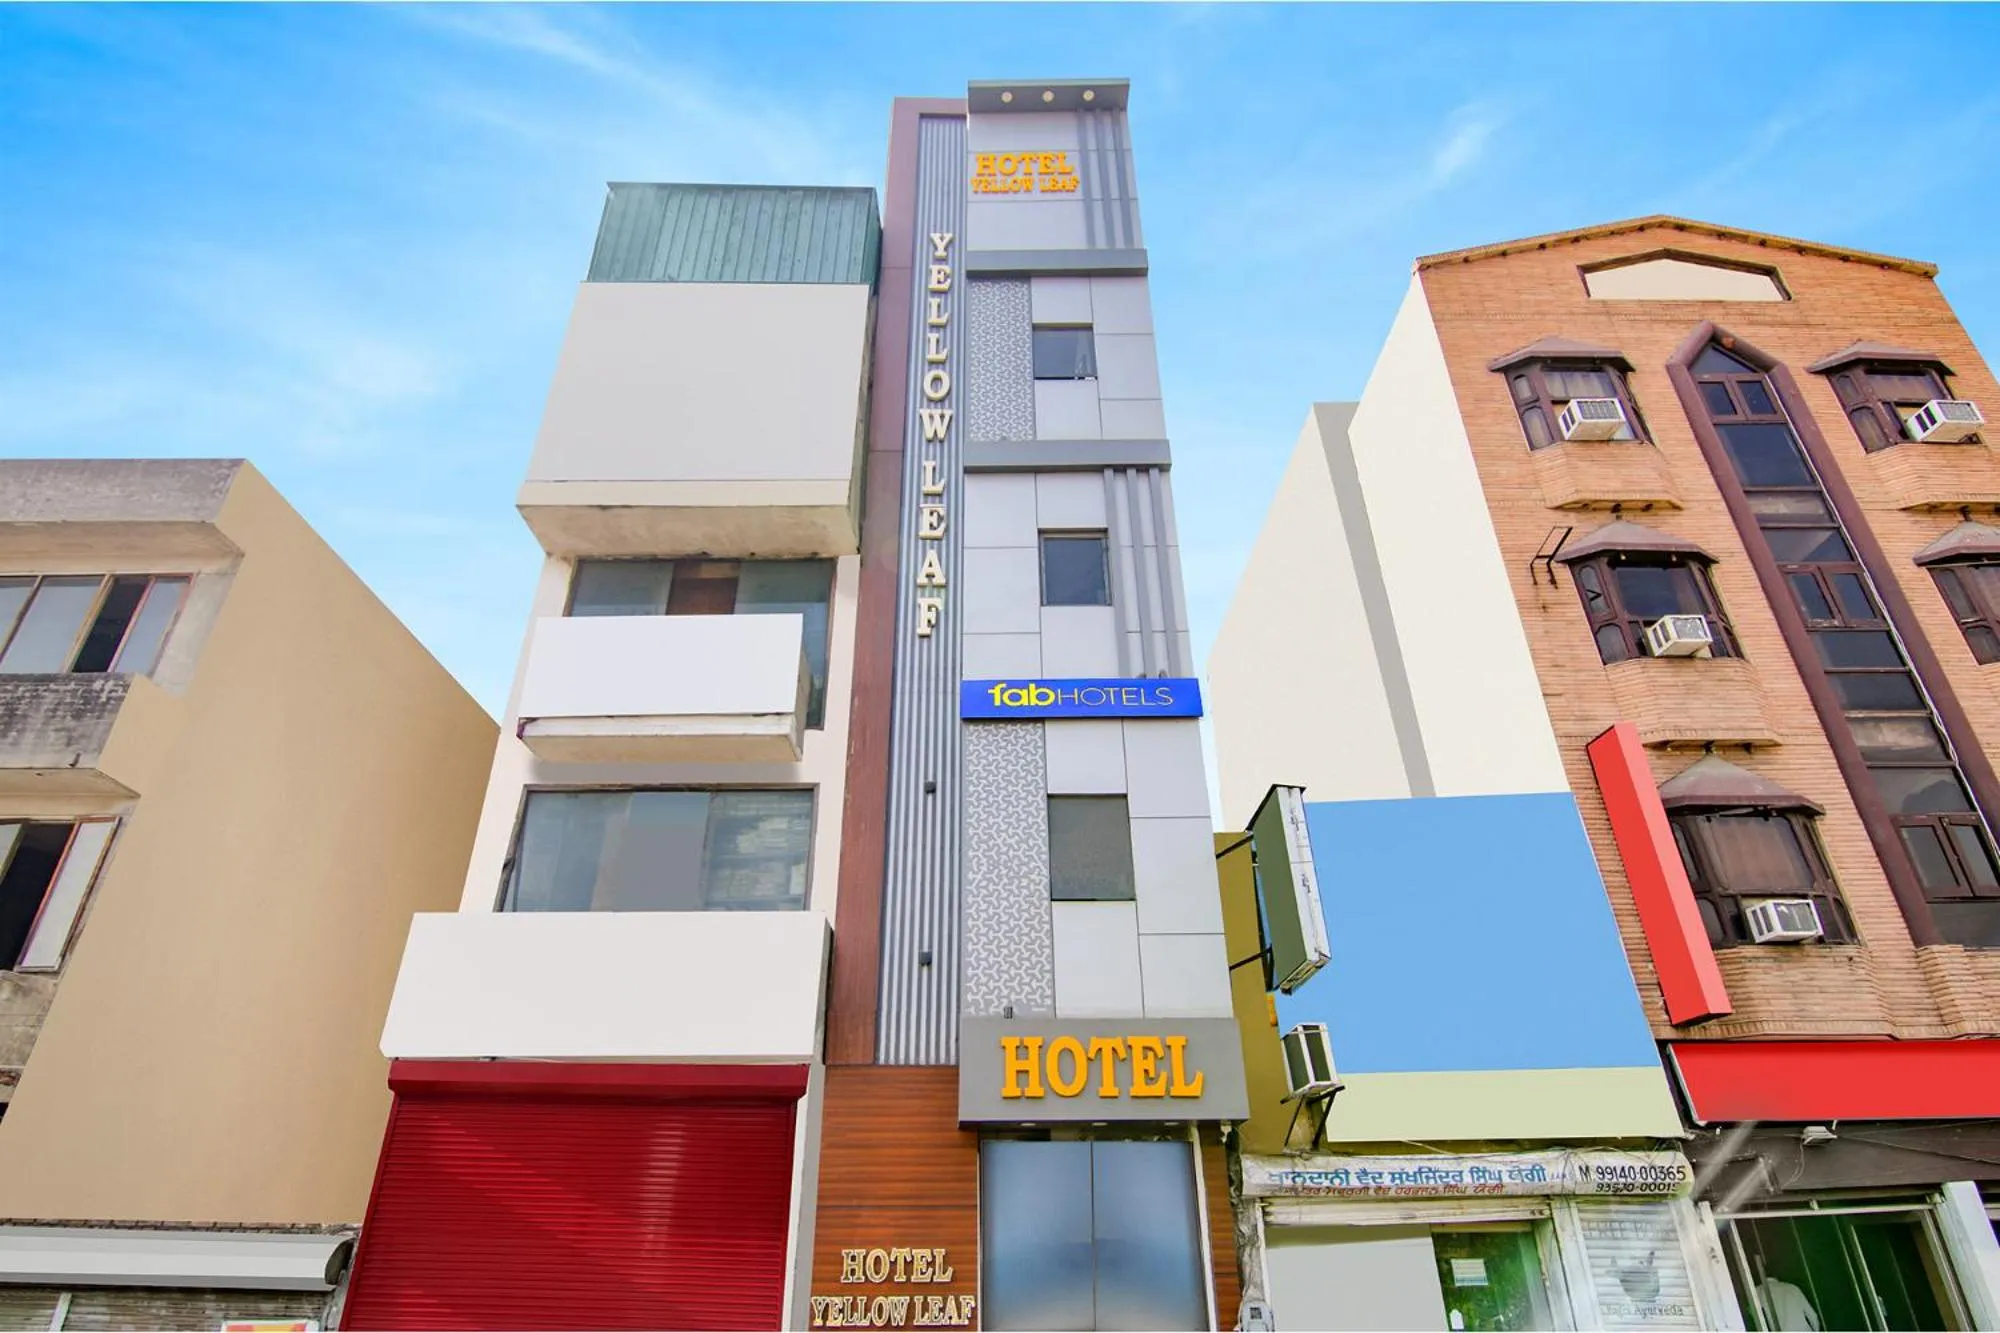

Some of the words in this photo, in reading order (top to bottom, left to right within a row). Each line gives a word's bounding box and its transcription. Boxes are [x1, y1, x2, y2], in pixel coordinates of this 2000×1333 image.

[975, 152, 1074, 176] HOTEL
[971, 176, 1034, 194] YELLOW
[1038, 175, 1080, 193] LEAF
[1000, 1035, 1204, 1098] HOTEL
[1469, 1165, 1504, 1184] ਸਿੰਘ
[840, 1247, 953, 1283] HOTEL
[811, 1296, 909, 1328] YELLOW
[912, 1295, 976, 1327] LEAF
